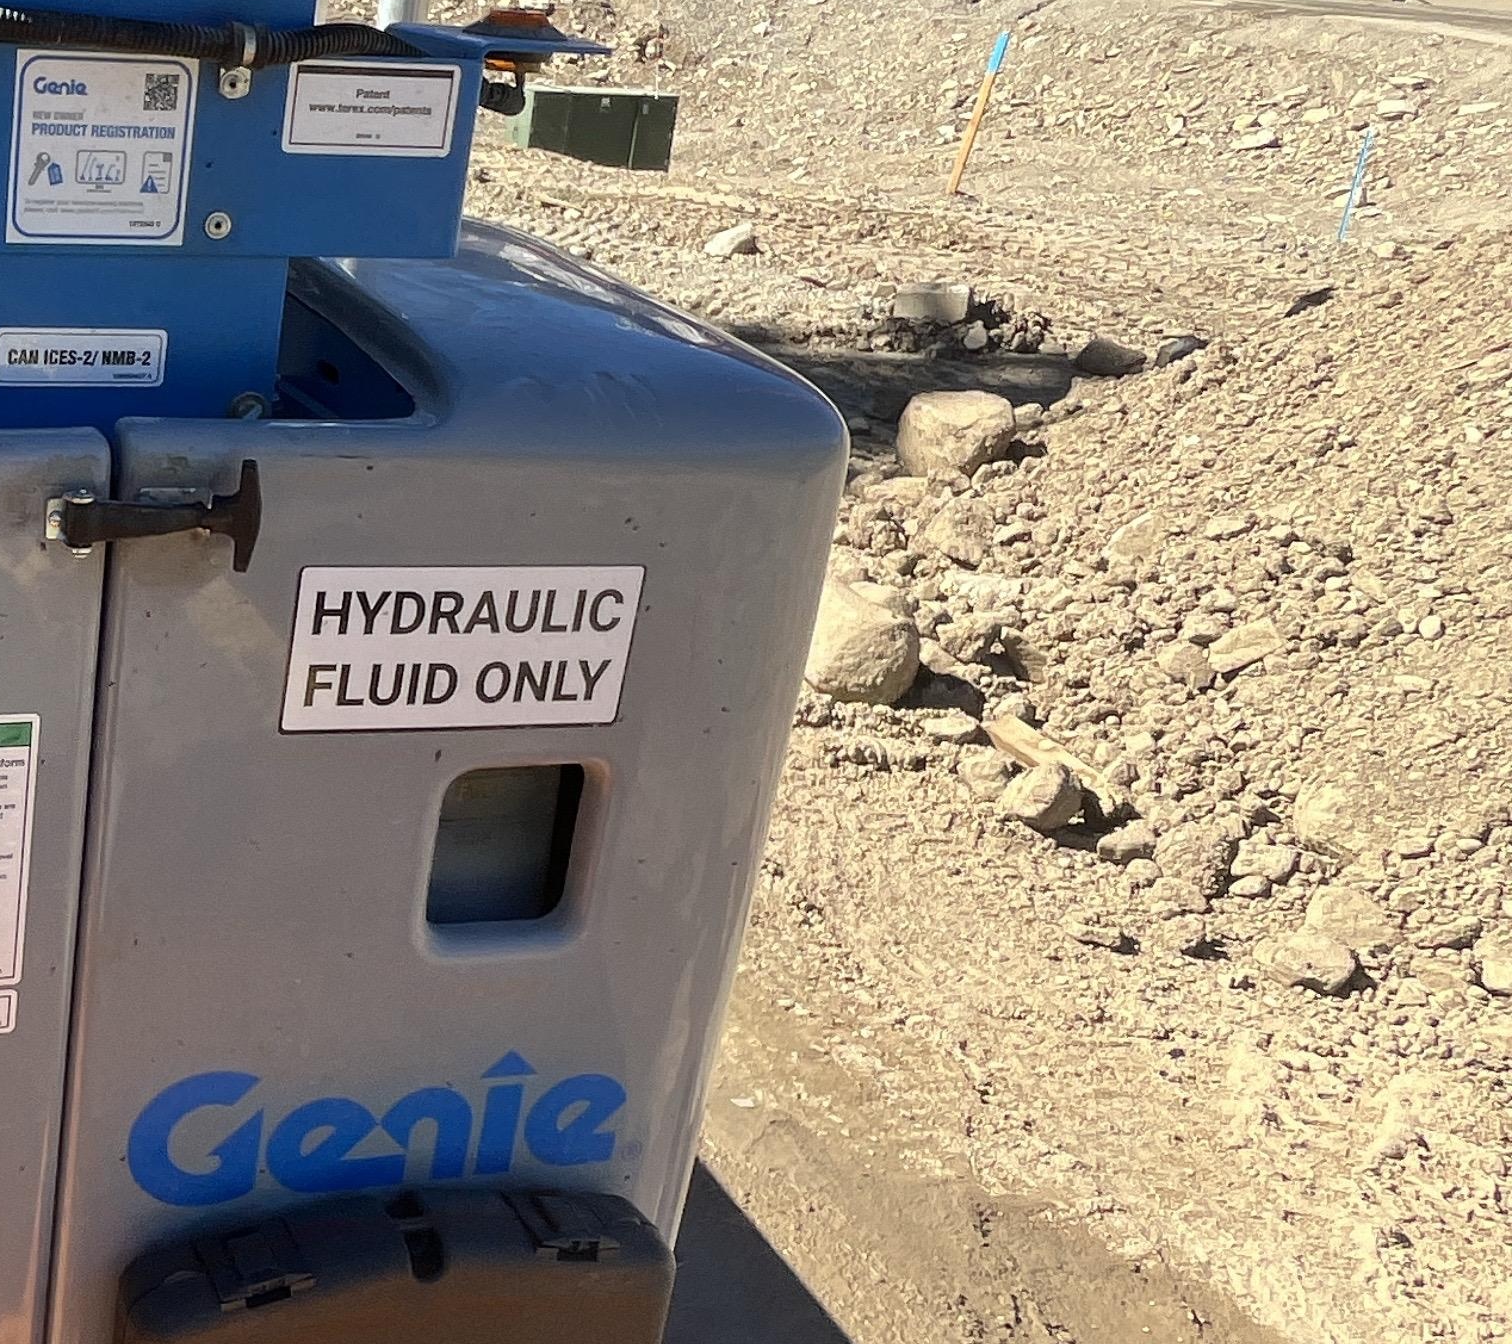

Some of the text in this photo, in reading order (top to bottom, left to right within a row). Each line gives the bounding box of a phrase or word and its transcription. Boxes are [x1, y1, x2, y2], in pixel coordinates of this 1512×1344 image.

[33, 77, 88, 96] Genie
[356, 89, 390, 99] Patent
[32, 123, 176, 139] PRODUCT REGISTRATION
[8, 349, 151, 366] CAN ICES-2/ NMB-2
[312, 589, 624, 635] HYDRAULIC
[303, 659, 611, 708] FLUID ONLY
[127, 1049, 625, 1207] Genie
